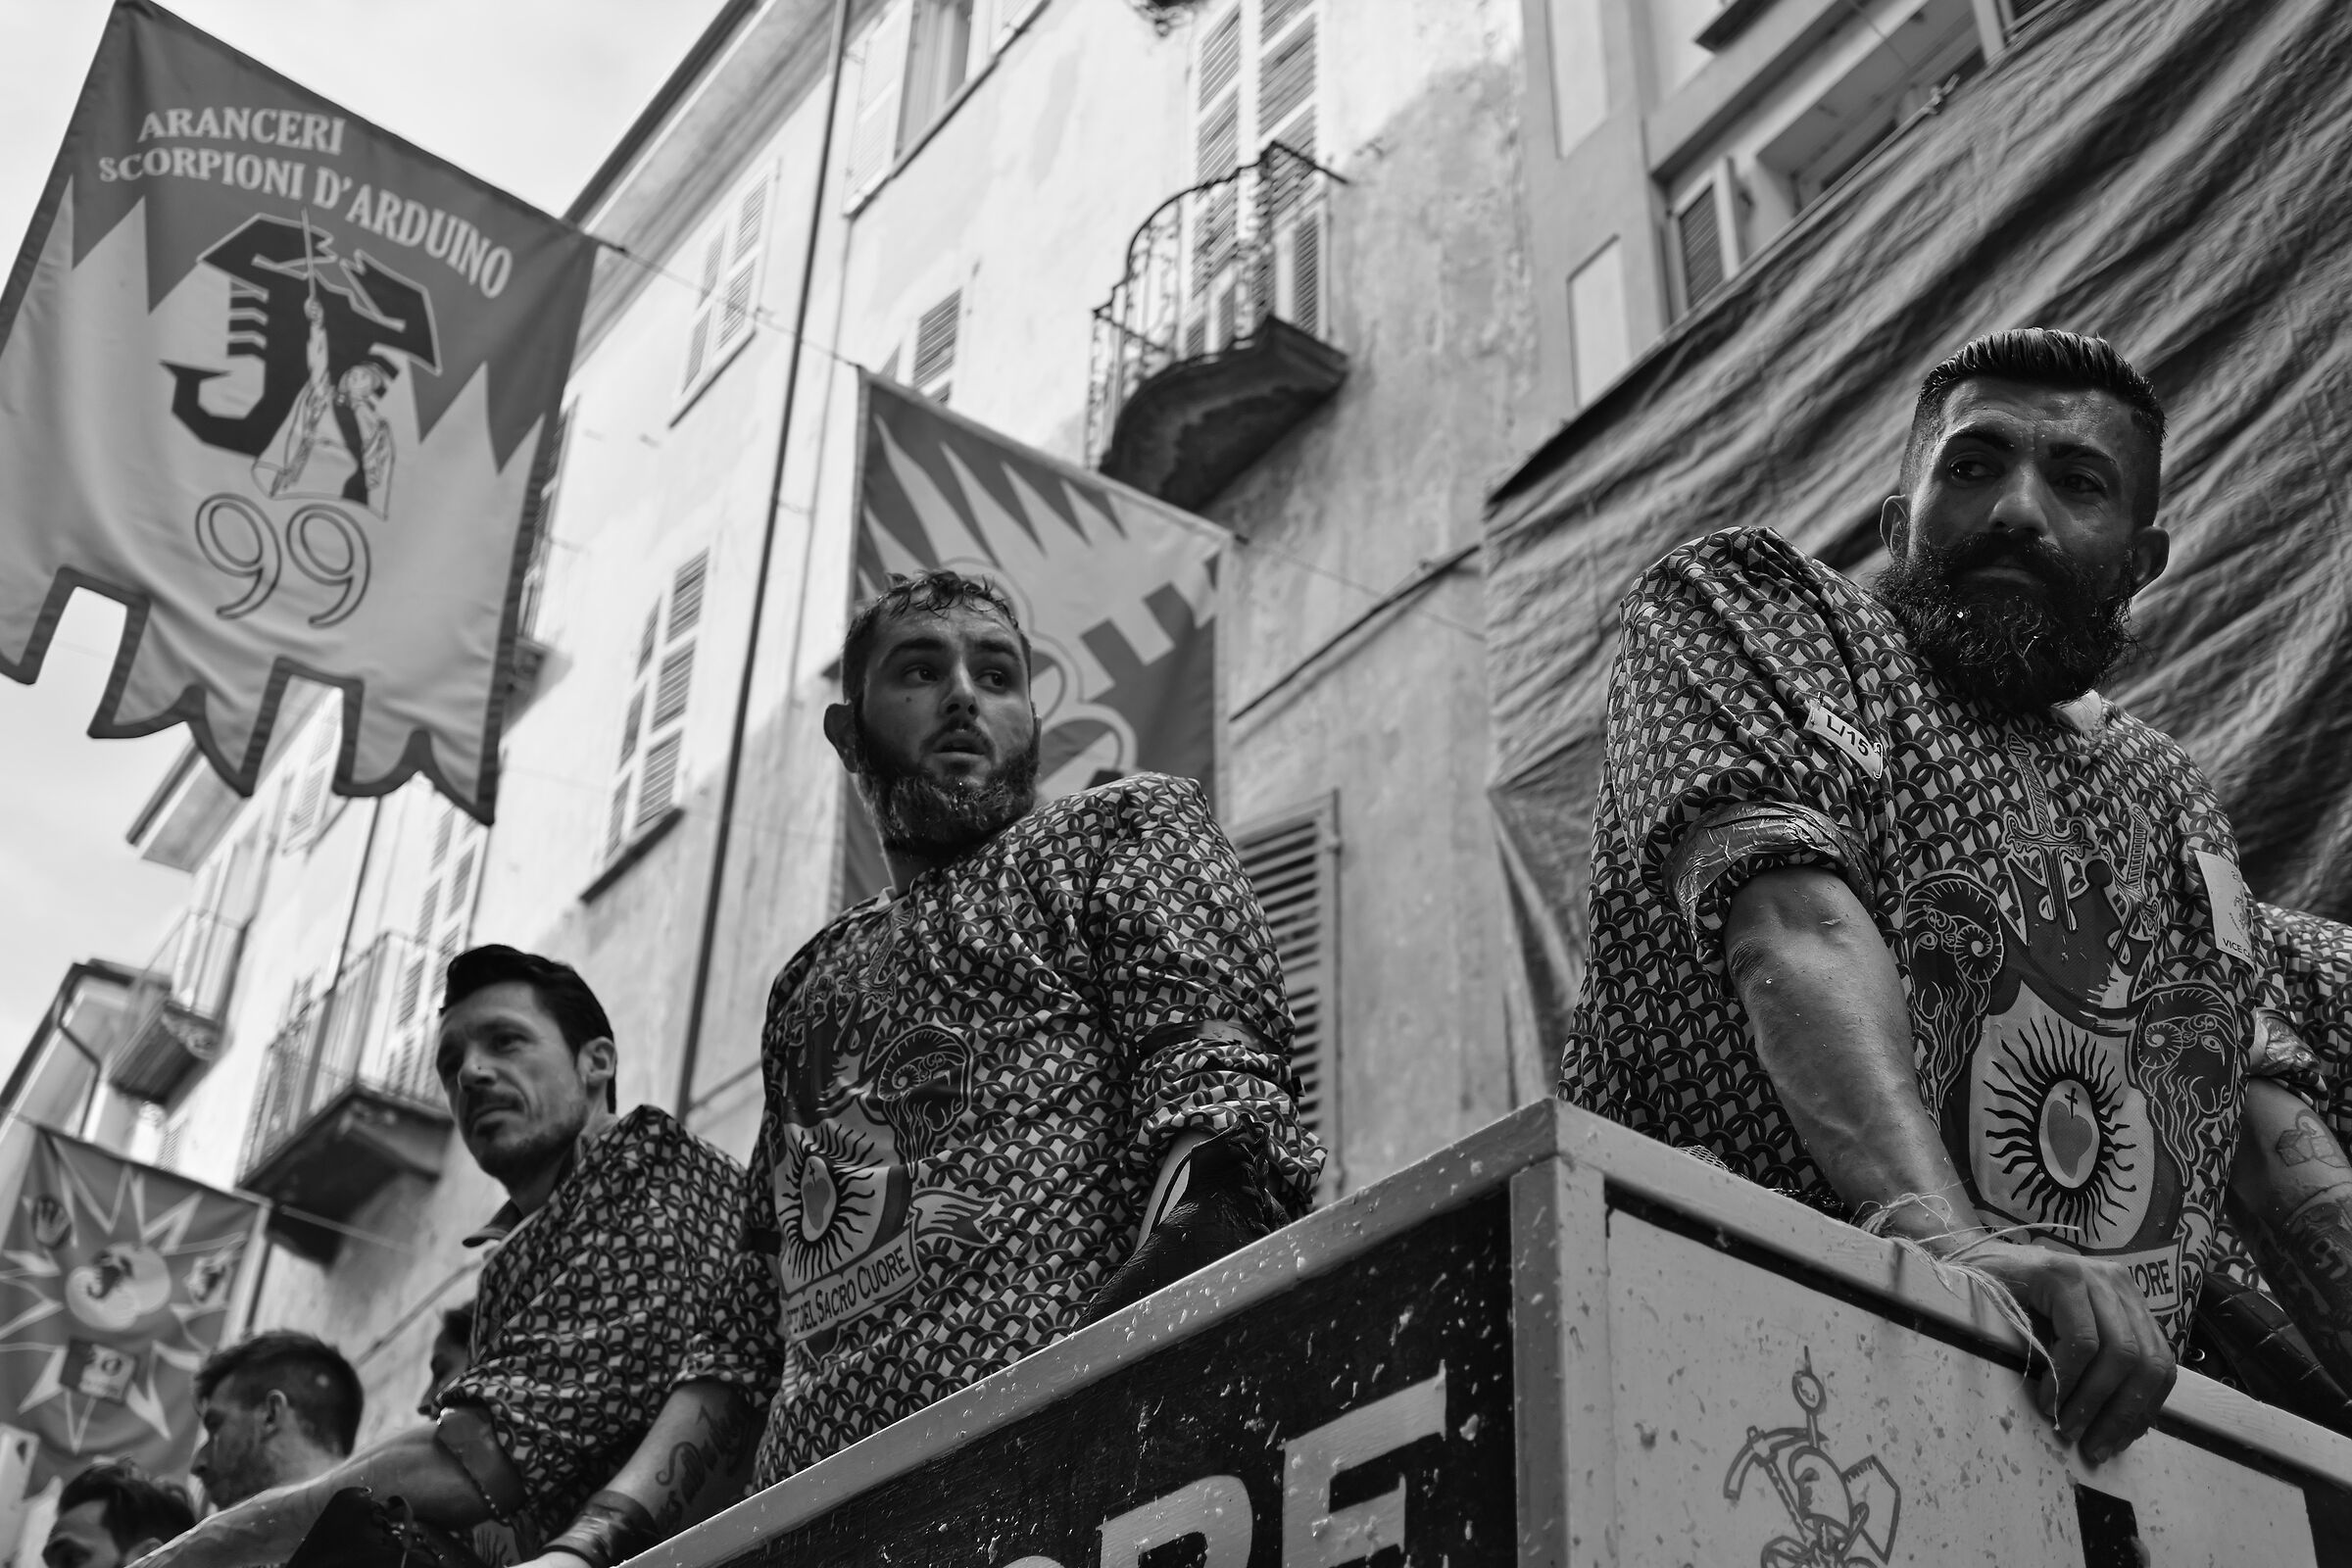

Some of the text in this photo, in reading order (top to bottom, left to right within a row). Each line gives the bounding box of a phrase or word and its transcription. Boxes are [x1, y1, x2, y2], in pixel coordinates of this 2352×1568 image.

[136, 106, 348, 156] ARANCERI
[98, 146, 514, 300] SCORPIONI D'ARDUINO
[195, 492, 371, 630] 99
[2222, 937, 2243, 955] VICE
[814, 1279, 858, 1324] SACRO
[858, 1246, 911, 1299] CUORE
